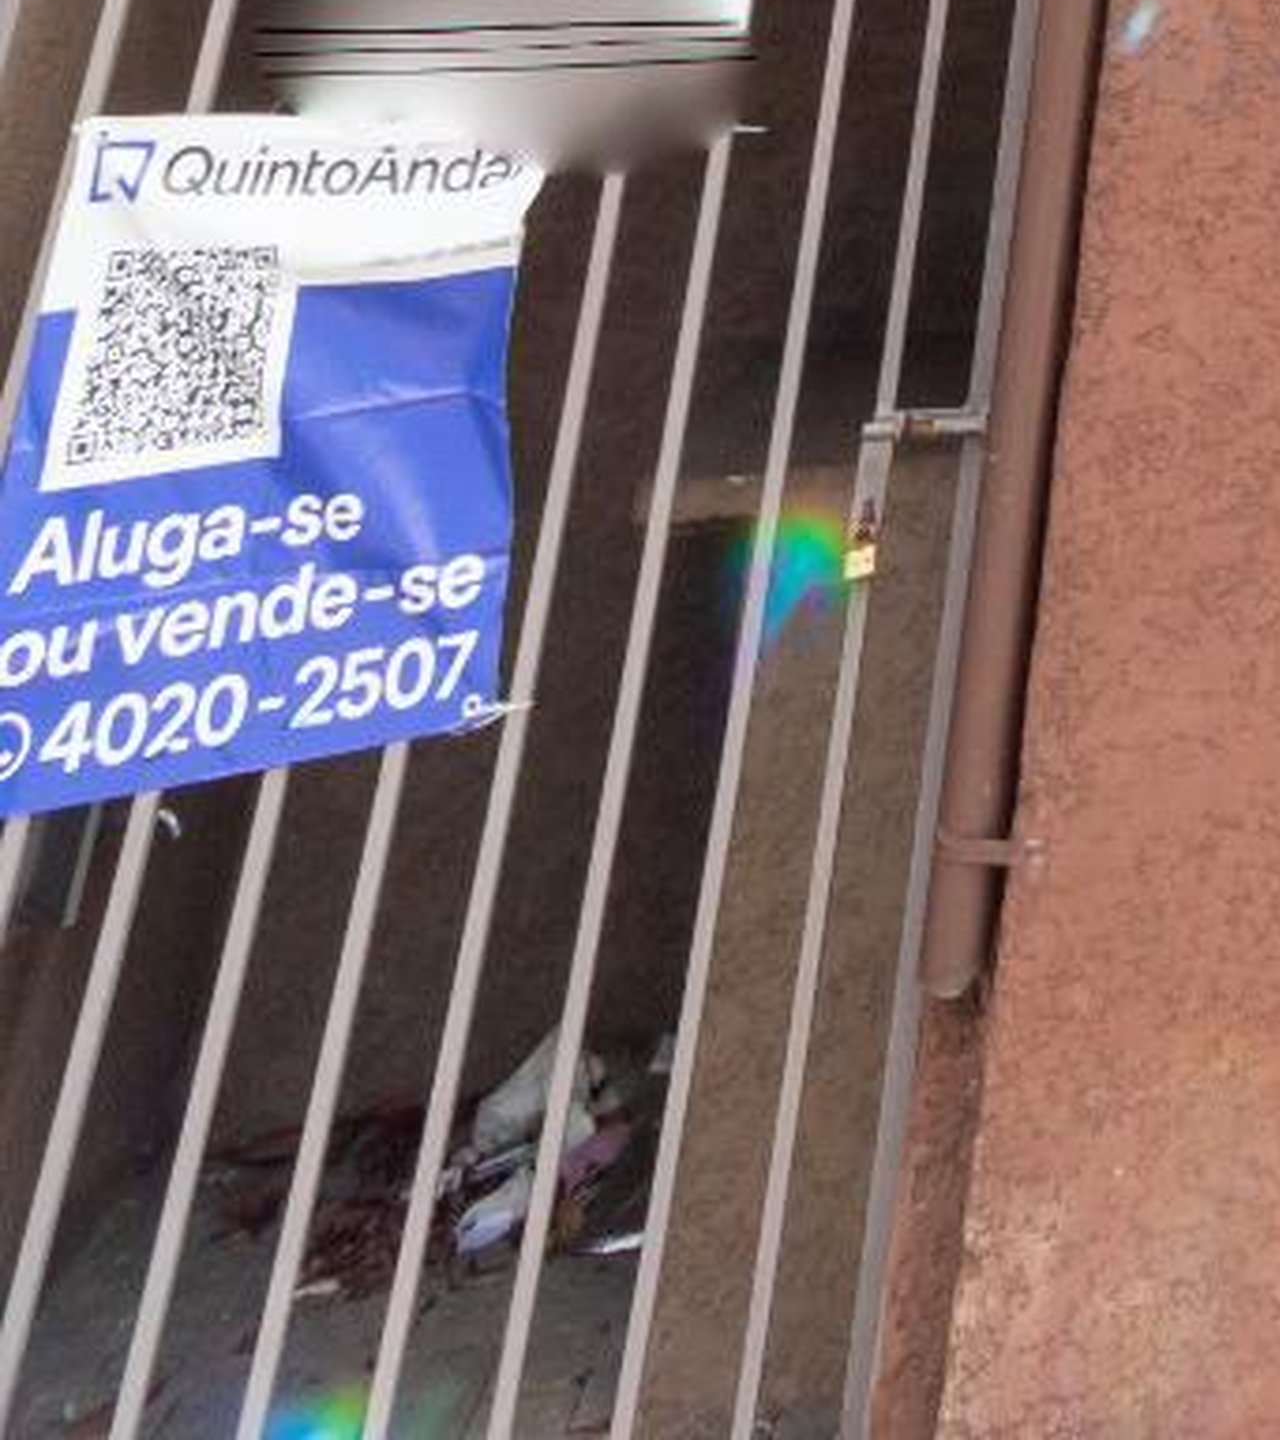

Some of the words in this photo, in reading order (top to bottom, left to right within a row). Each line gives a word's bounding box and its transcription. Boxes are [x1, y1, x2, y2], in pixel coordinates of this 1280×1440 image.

[6, 492, 364, 596] Aluga-se
[0, 618, 99, 688] ou
[115, 553, 485, 666] vende-se
[38, 629, 480, 774] 4020-2507
